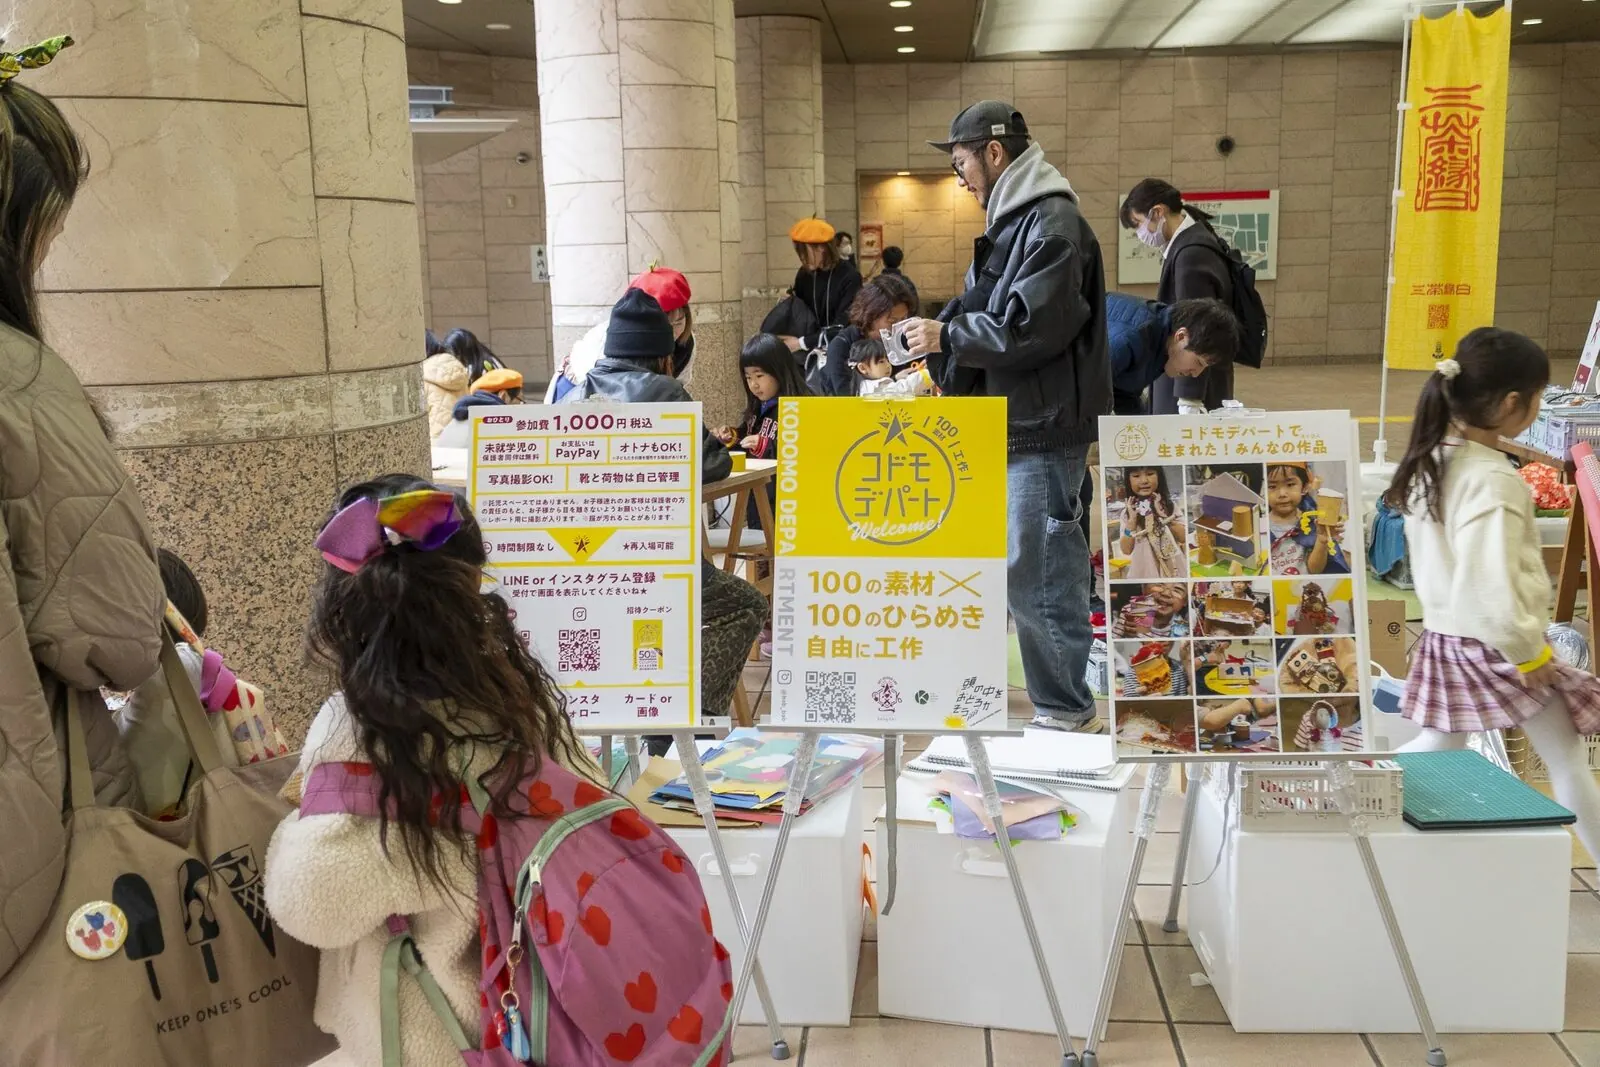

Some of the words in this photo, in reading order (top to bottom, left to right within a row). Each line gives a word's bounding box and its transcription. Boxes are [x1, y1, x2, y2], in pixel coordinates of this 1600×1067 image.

[516, 419, 549, 431] 参加費
[630, 417, 653, 429] 税込
[936, 415, 958, 437] 100
[1181, 424, 1304, 440] コドモデパートで
[485, 442, 537, 453] 未就学児の
[555, 448, 600, 459] PayPay
[620, 442, 682, 453] オトナもOK!
[780, 400, 800, 493] KODOMO
[861, 453, 931, 482] コドモ
[488, 474, 553, 485] 写真撮影OK!
[579, 471, 680, 483] 靴と荷物は自己管理
[854, 485, 940, 517] デパート
[848, 510, 946, 541] Welcome!
[497, 543, 554, 552] 時間制限なし
[503, 575, 529, 586] LINE
[532, 577, 545, 585] or
[549, 572, 656, 584] インスタグラム登録
[626, 606, 672, 615] 招待クーポン
[807, 603, 984, 629] 100のひらめき
[807, 635, 924, 660] 自由に工作
[624, 694, 656, 704] カード
[661, 695, 672, 703] or
[637, 706, 659, 717] 画像
[156, 1014, 190, 1034] KEEP
[196, 998, 242, 1022] ONE'S
[248, 975, 292, 1004] COOL
